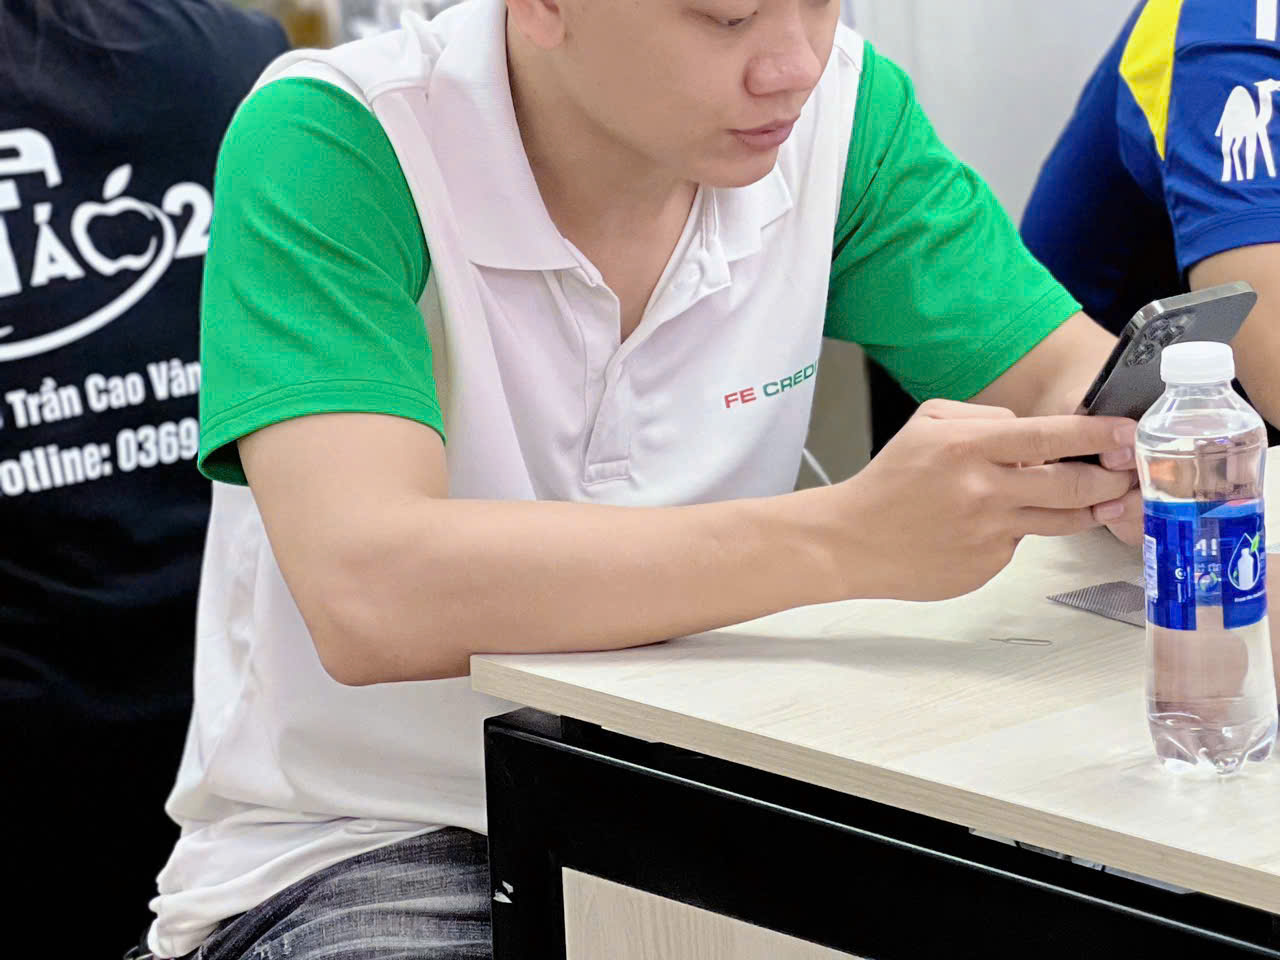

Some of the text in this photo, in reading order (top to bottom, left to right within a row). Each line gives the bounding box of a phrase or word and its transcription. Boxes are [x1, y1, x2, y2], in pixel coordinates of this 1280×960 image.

[84, 372, 145, 412] Cao
[723, 386, 758, 409] FE
[0, 417, 199, 497] otline: 0369
